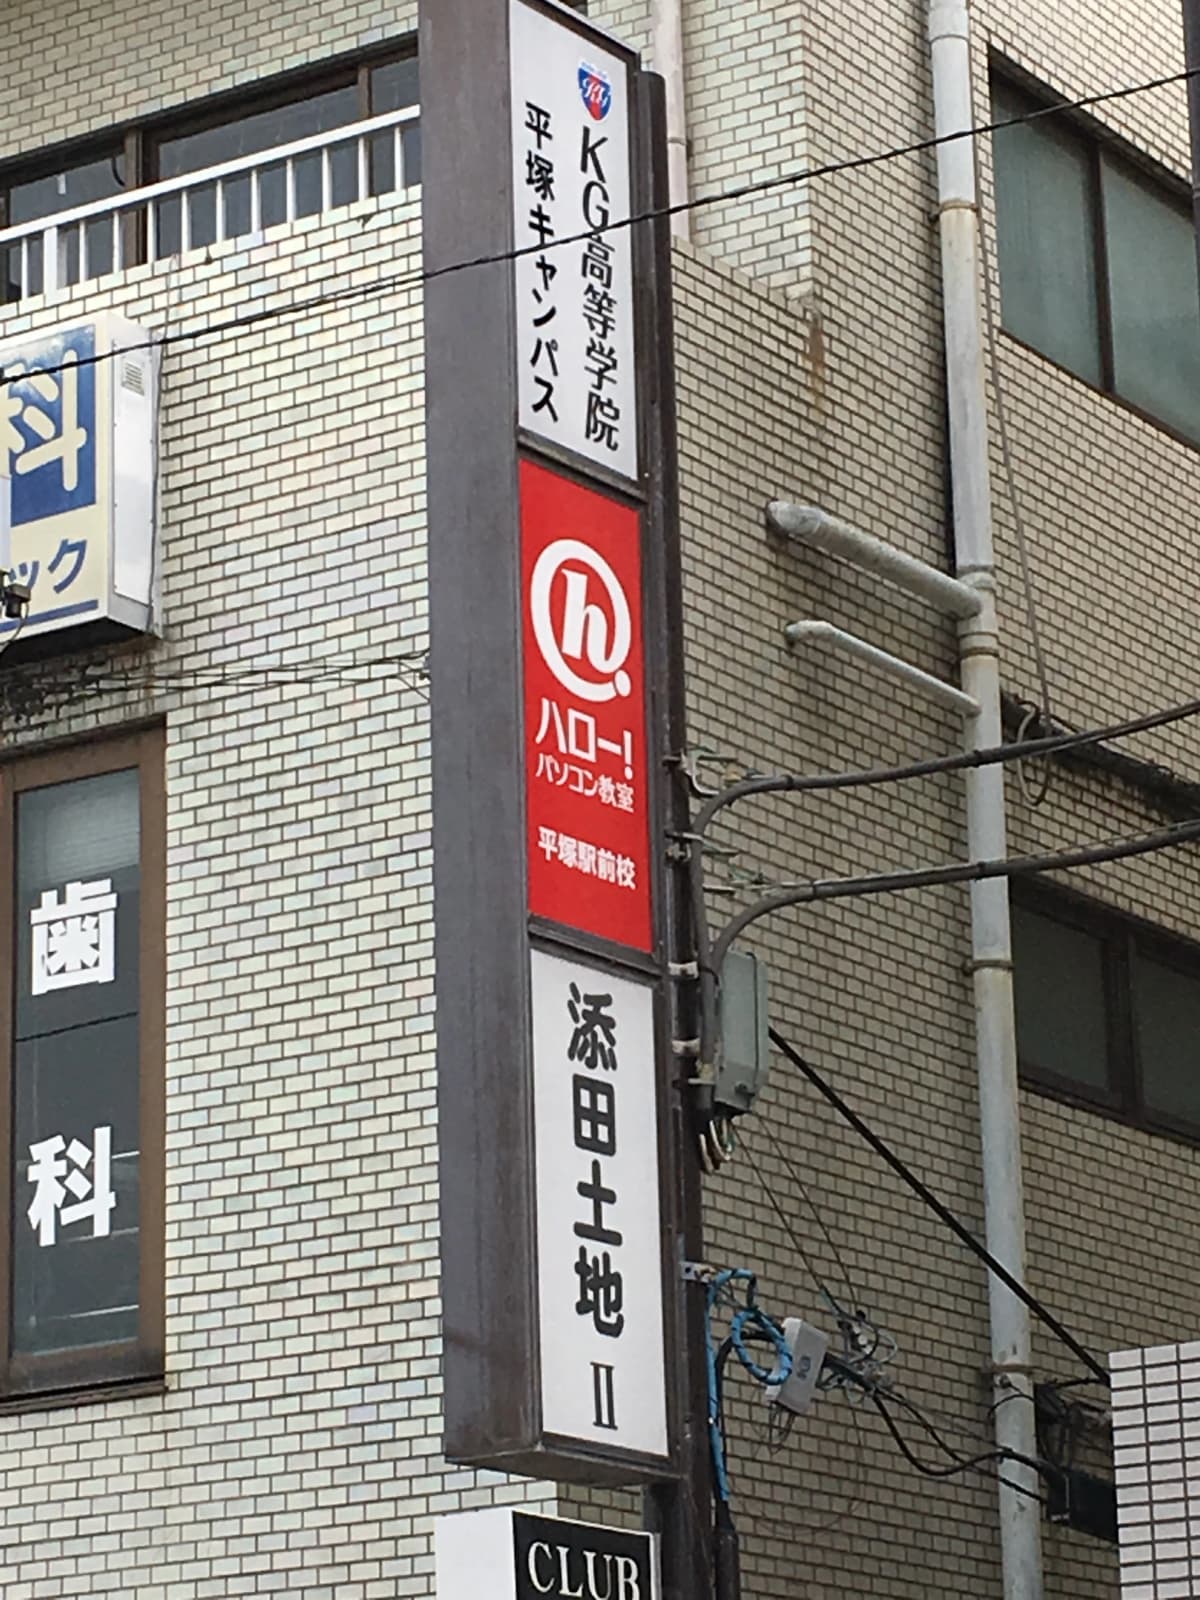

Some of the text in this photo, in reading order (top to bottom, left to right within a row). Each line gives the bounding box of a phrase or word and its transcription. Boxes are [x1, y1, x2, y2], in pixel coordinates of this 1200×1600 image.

[524, 101, 559, 422] 平塚キャンパス
[580, 126, 620, 452] KG高等学院
[0, 349, 87, 491] 科
[535, 752, 635, 813] パソコン教室
[538, 825, 636, 890] 平塚駅前校
[567, 981, 624, 1338] 添田土地
[528, 1541, 640, 1600] CLUB
